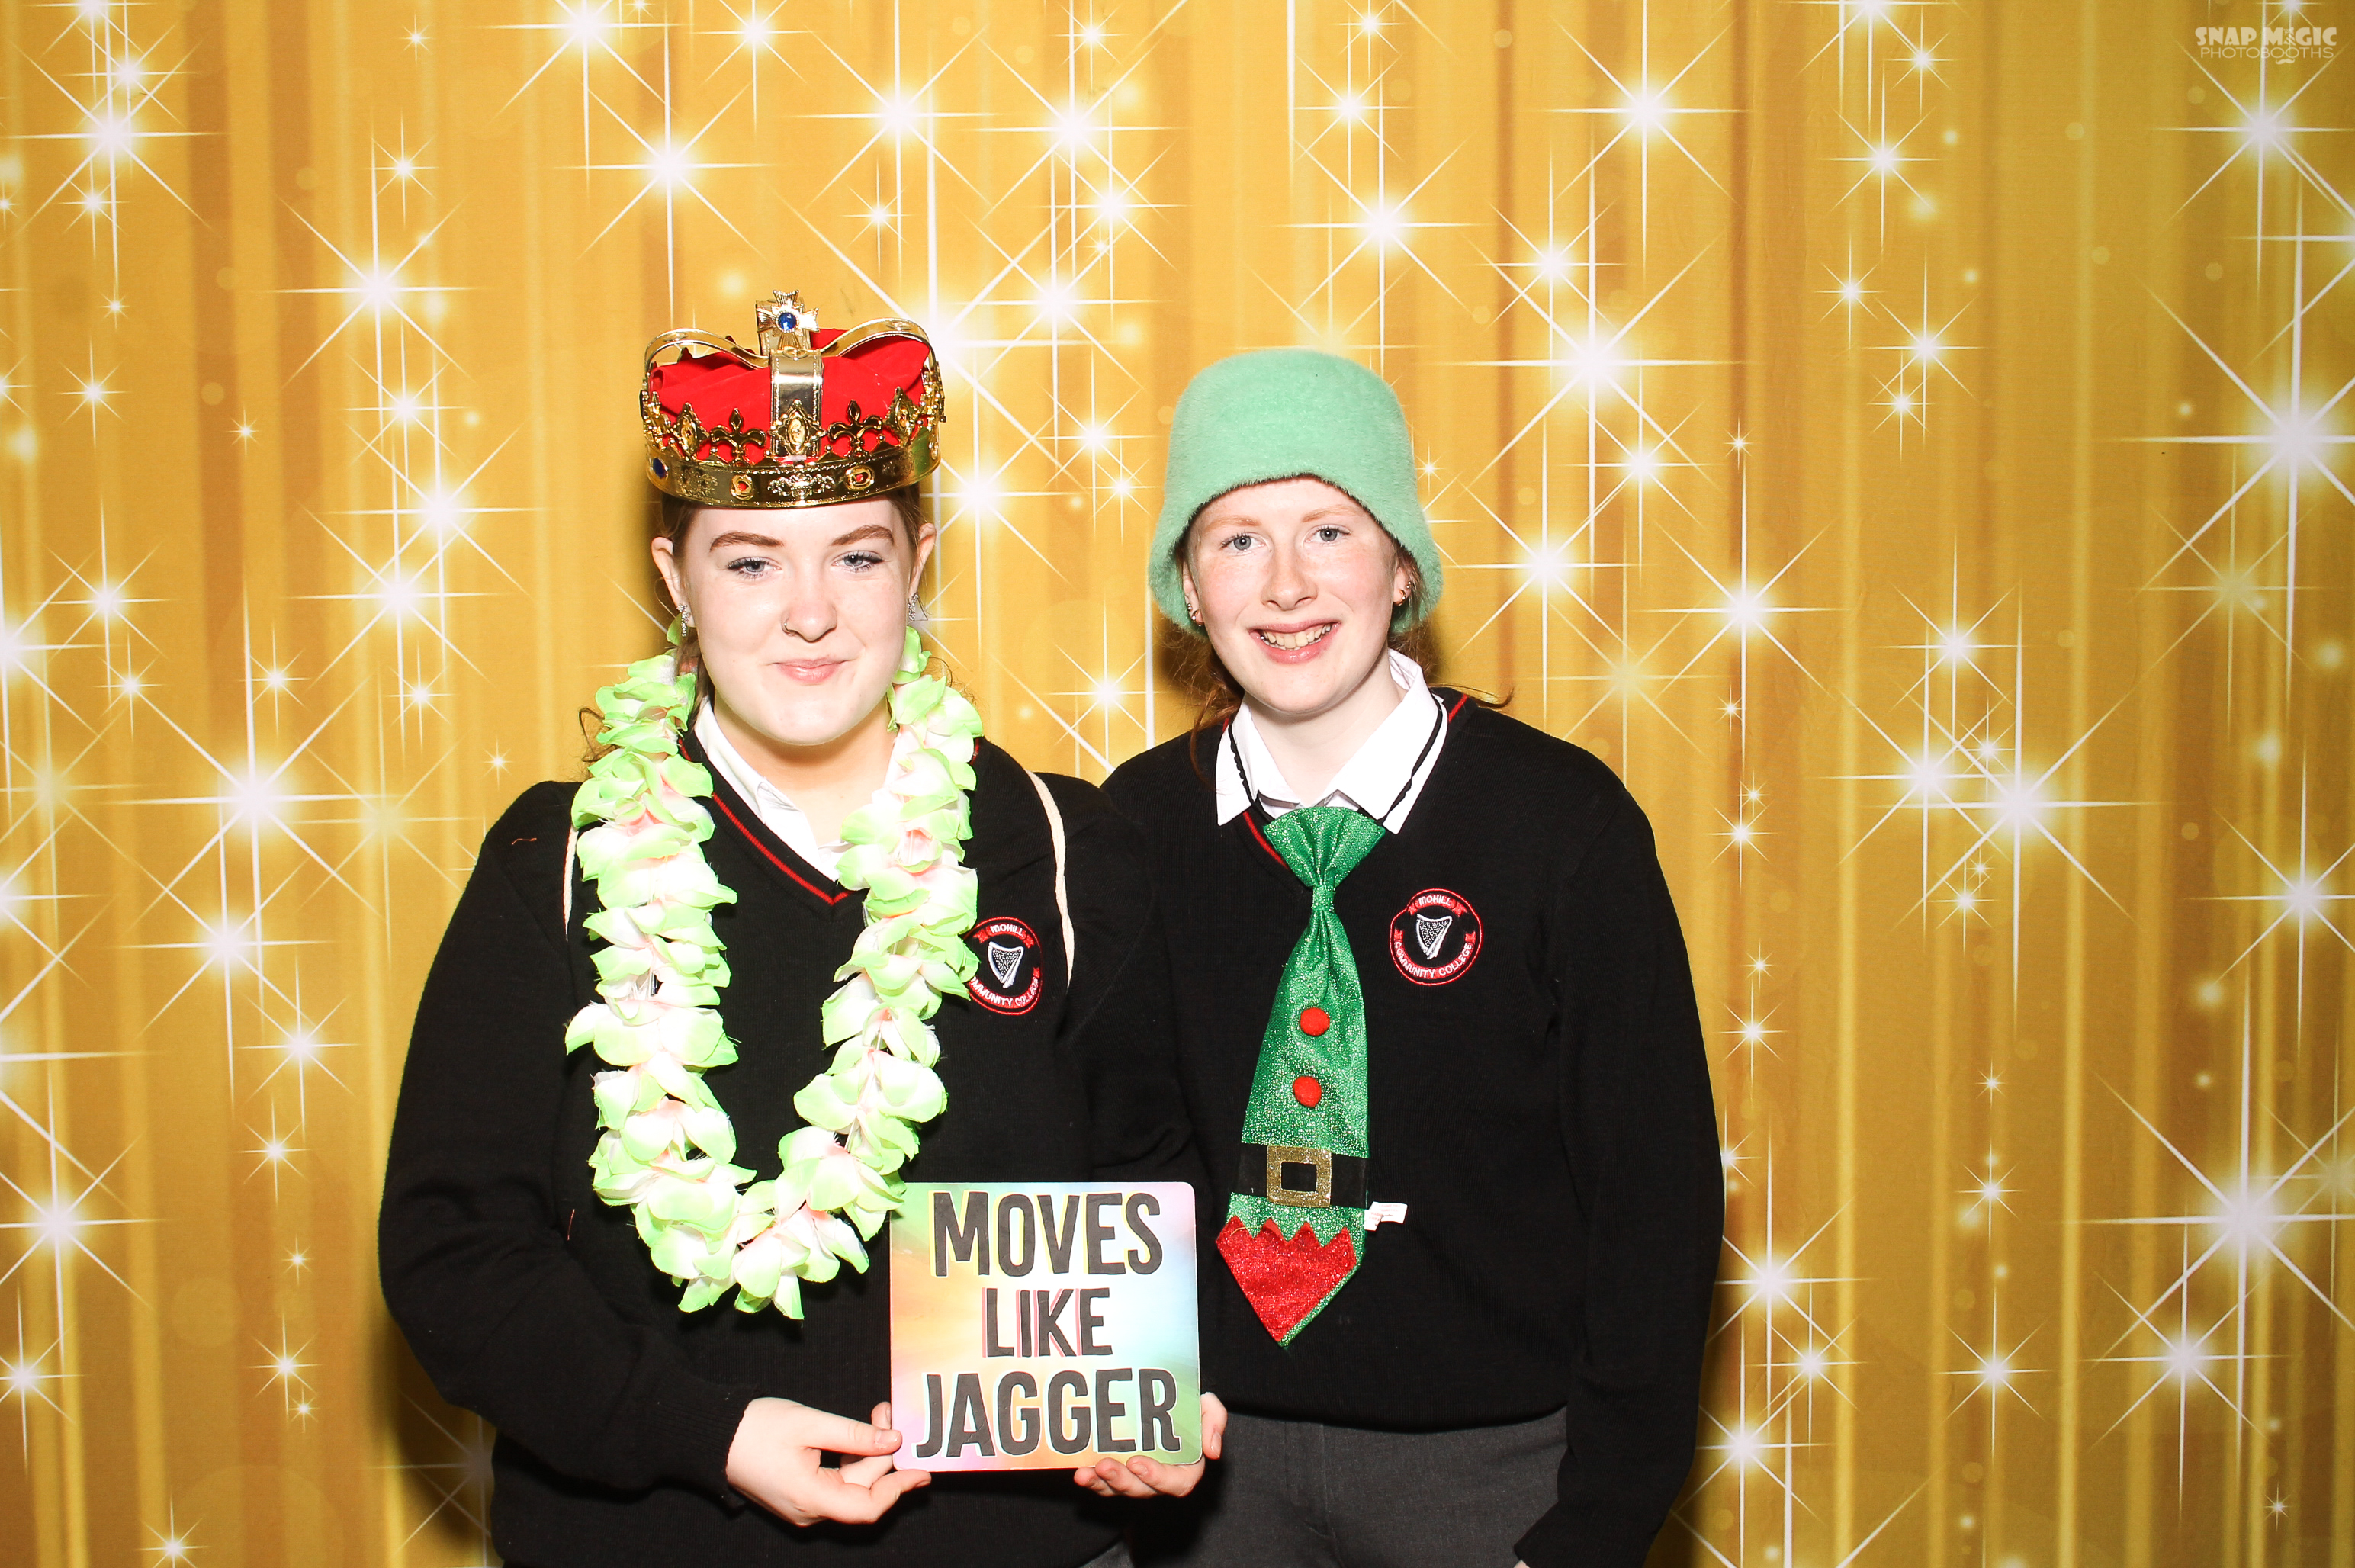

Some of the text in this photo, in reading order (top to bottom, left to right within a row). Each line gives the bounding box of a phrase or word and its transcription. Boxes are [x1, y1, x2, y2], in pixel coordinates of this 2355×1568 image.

[1418, 895, 1451, 906] MOHILL
[990, 924, 1023, 937] MOHILL
[1394, 941, 1473, 978] COMMUNITY COLLEGE
[969, 976, 1014, 1007] MMUNITY
[929, 1190, 1163, 1277] MOVES
[982, 1287, 1113, 1358] LIKE
[913, 1367, 1182, 1458] JAGGER
